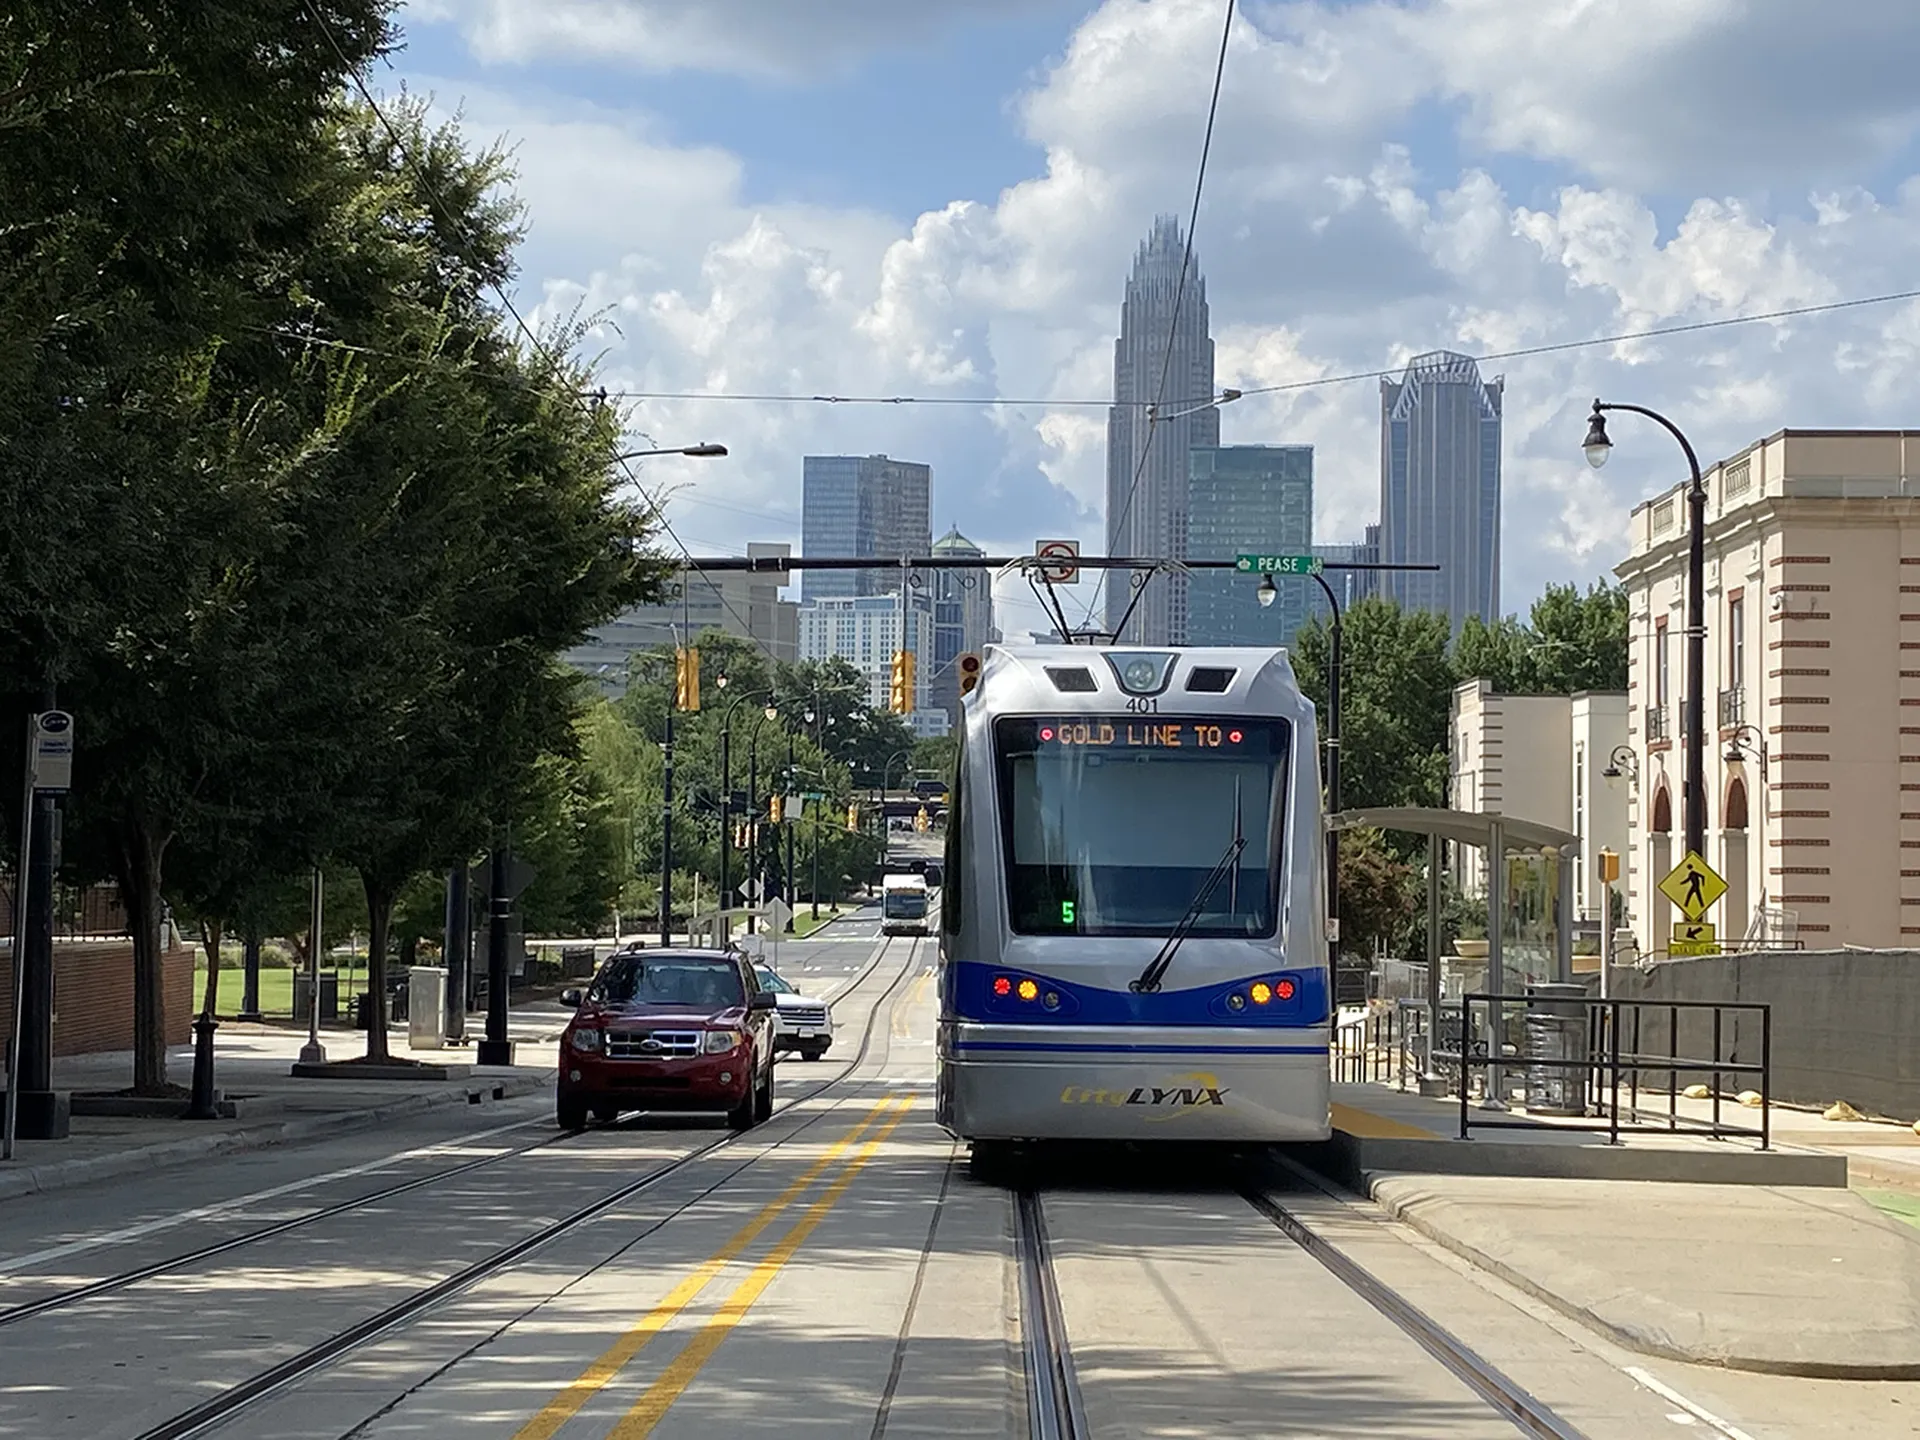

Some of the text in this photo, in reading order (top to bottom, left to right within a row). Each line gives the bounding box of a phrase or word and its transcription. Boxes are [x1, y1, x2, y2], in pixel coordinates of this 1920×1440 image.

[1419, 371, 1469, 384] TRUIST
[1258, 557, 1299, 572] PEASE
[1126, 698, 1158, 714] 401
[1058, 725, 1222, 747] GOLD LINE TO
[1062, 901, 1075, 924] 5
